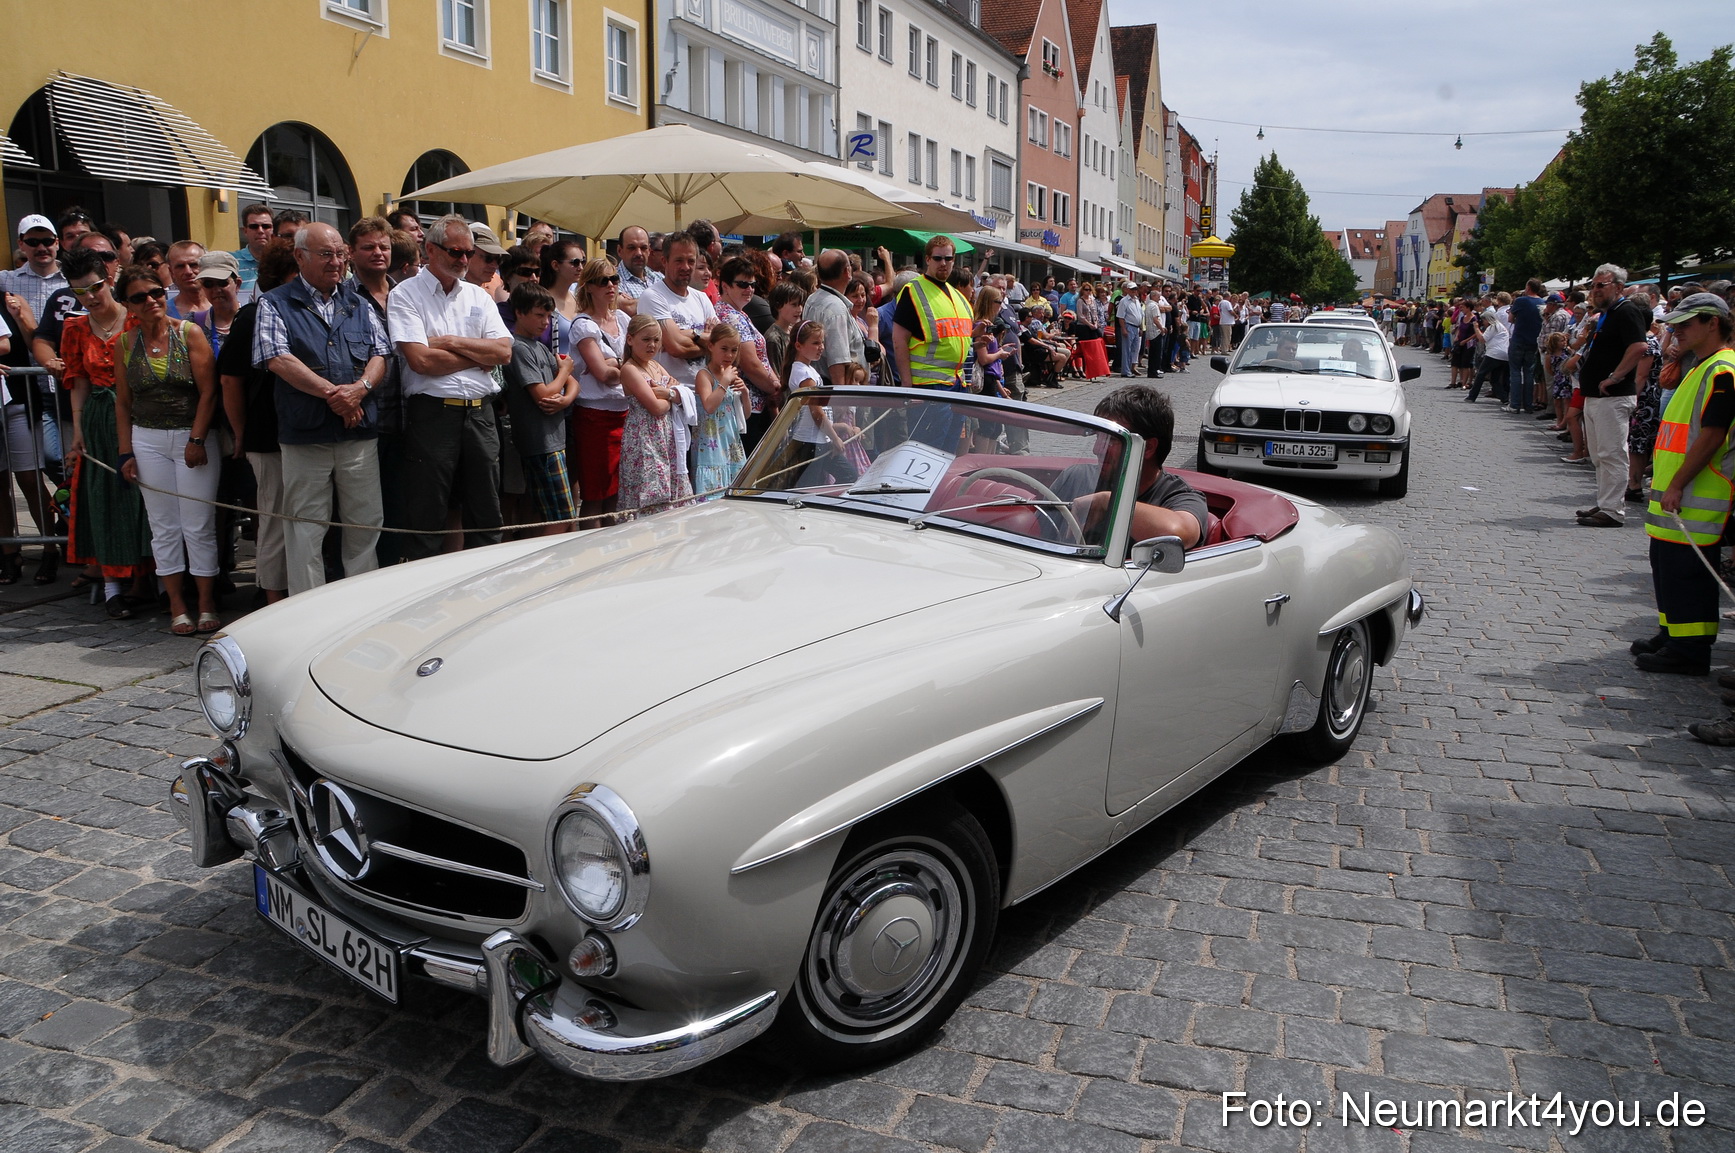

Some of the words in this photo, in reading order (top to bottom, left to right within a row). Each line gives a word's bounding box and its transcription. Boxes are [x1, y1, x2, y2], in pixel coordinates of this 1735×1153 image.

[724, 2, 762, 37] BRILLEN
[760, 19, 793, 52] WEBER
[1272, 443, 1286, 455] RH
[1292, 444, 1305, 456] CA
[1307, 445, 1327, 457] 325
[902, 458, 931, 480] 12
[266, 877, 294, 929] NM
[306, 906, 337, 958] SL
[342, 929, 393, 993] 62H
